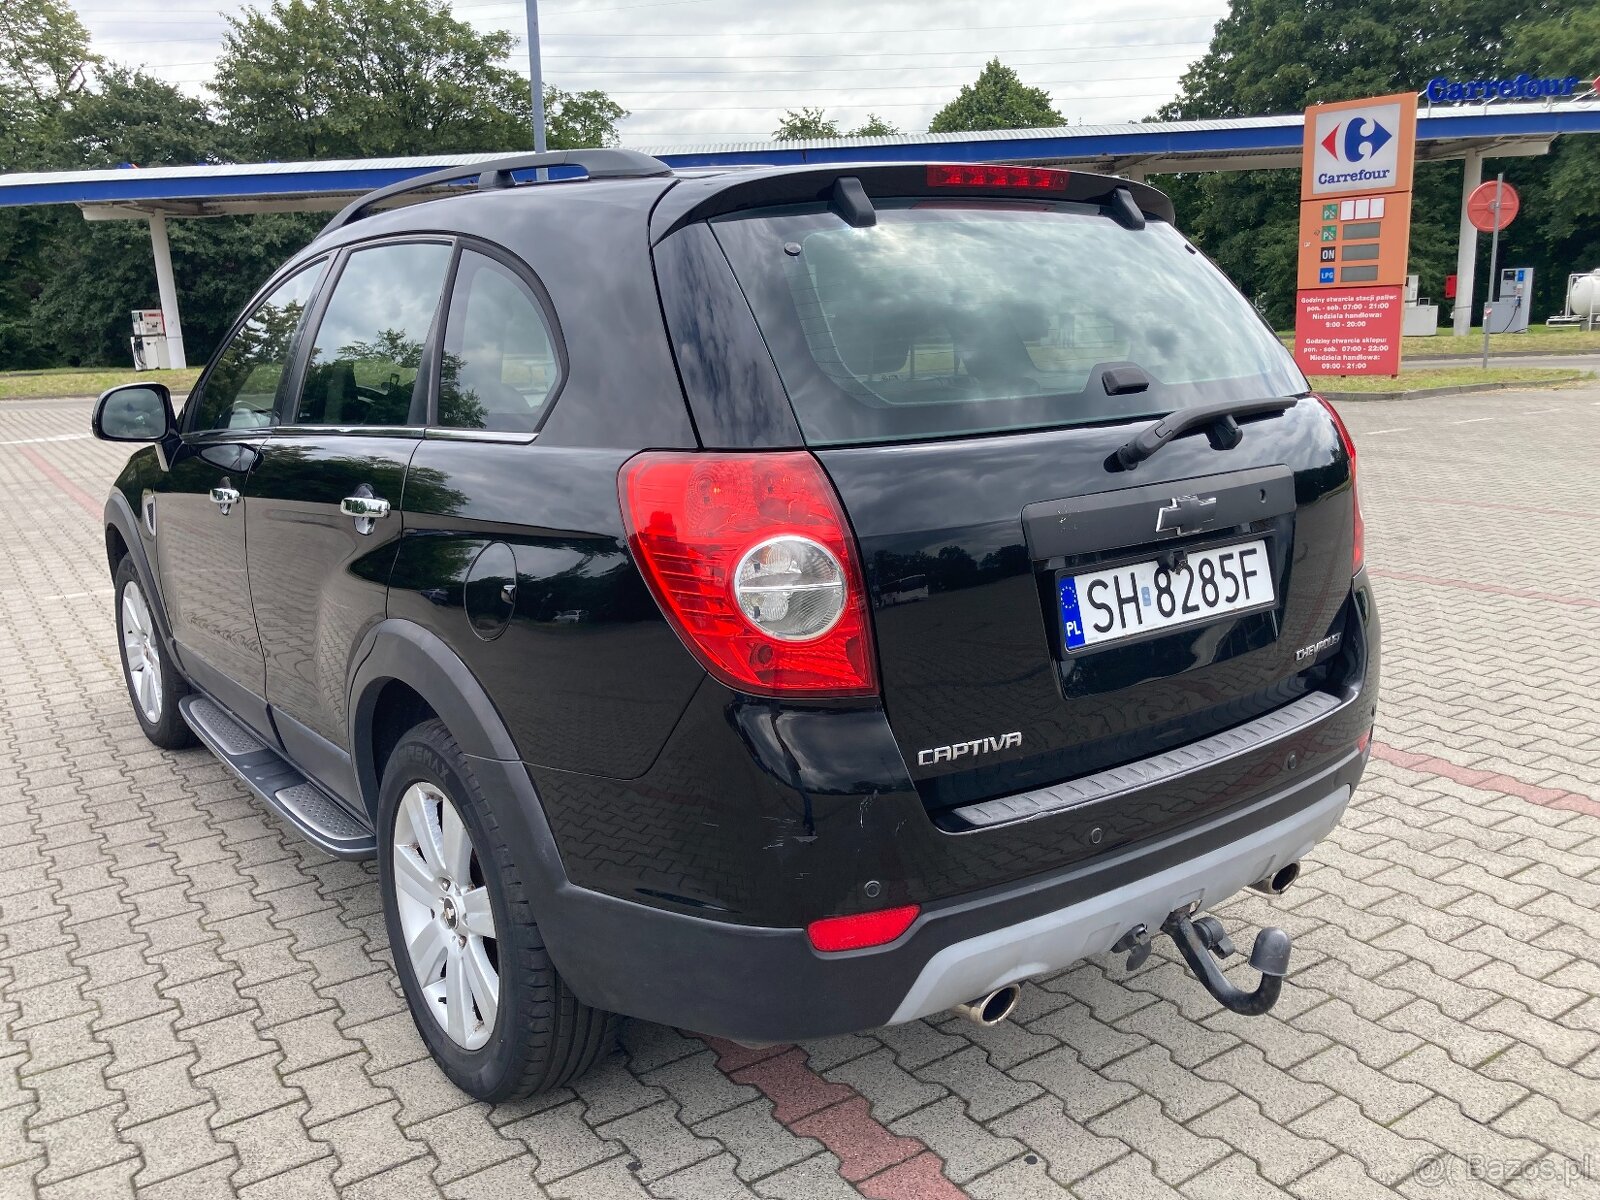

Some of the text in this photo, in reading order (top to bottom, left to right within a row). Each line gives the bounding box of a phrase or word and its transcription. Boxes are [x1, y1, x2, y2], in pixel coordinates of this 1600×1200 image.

[1427, 73, 1579, 102] Carrefour
[1318, 168, 1390, 185] Carrefour
[1322, 249, 1335, 260] ON
[1321, 272, 1334, 280] LPG
[1087, 548, 1259, 633] SH 8285F
[1066, 621, 1082, 637] PL
[918, 731, 1022, 766] CAPTIVA
